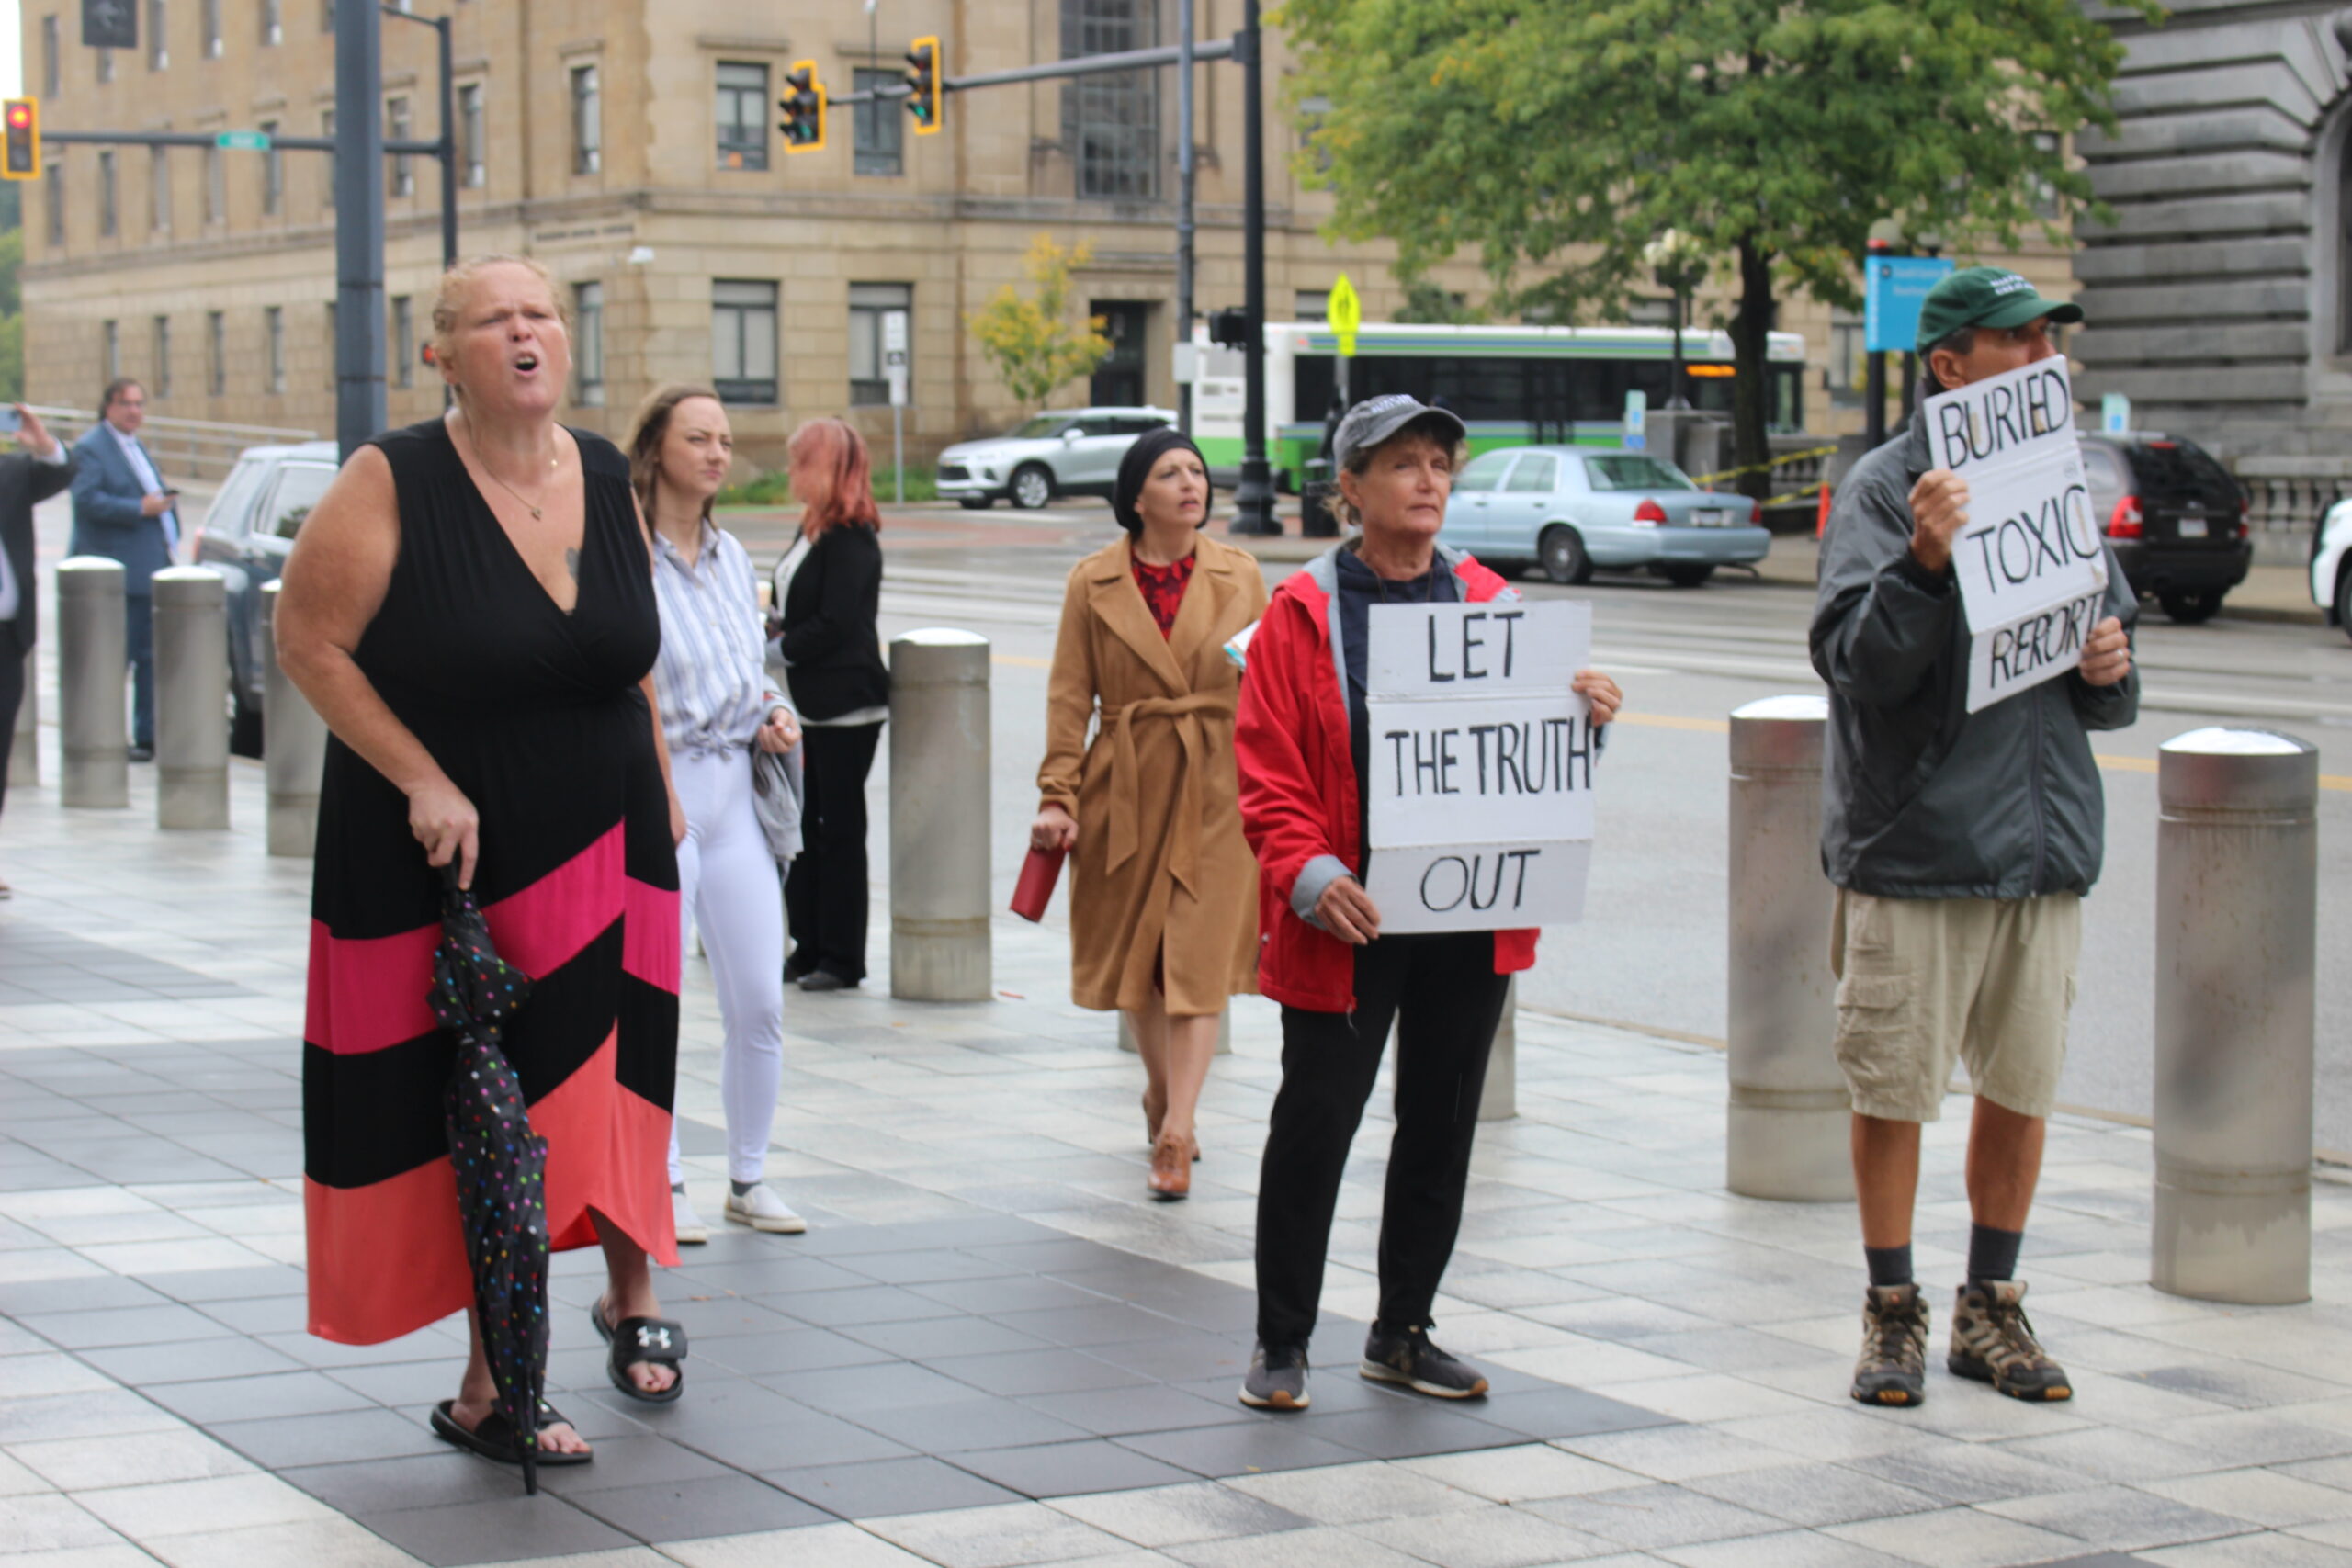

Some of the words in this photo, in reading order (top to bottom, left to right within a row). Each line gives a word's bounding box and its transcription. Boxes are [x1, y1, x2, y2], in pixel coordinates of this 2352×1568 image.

[1940, 369, 2068, 468] BURIED
[1966, 484, 2101, 594] TOXIC
[1429, 611, 1524, 682] LET
[1385, 728, 1460, 796] THE
[1468, 712, 1591, 795] TRUTH
[1420, 849, 1541, 912] OUT
